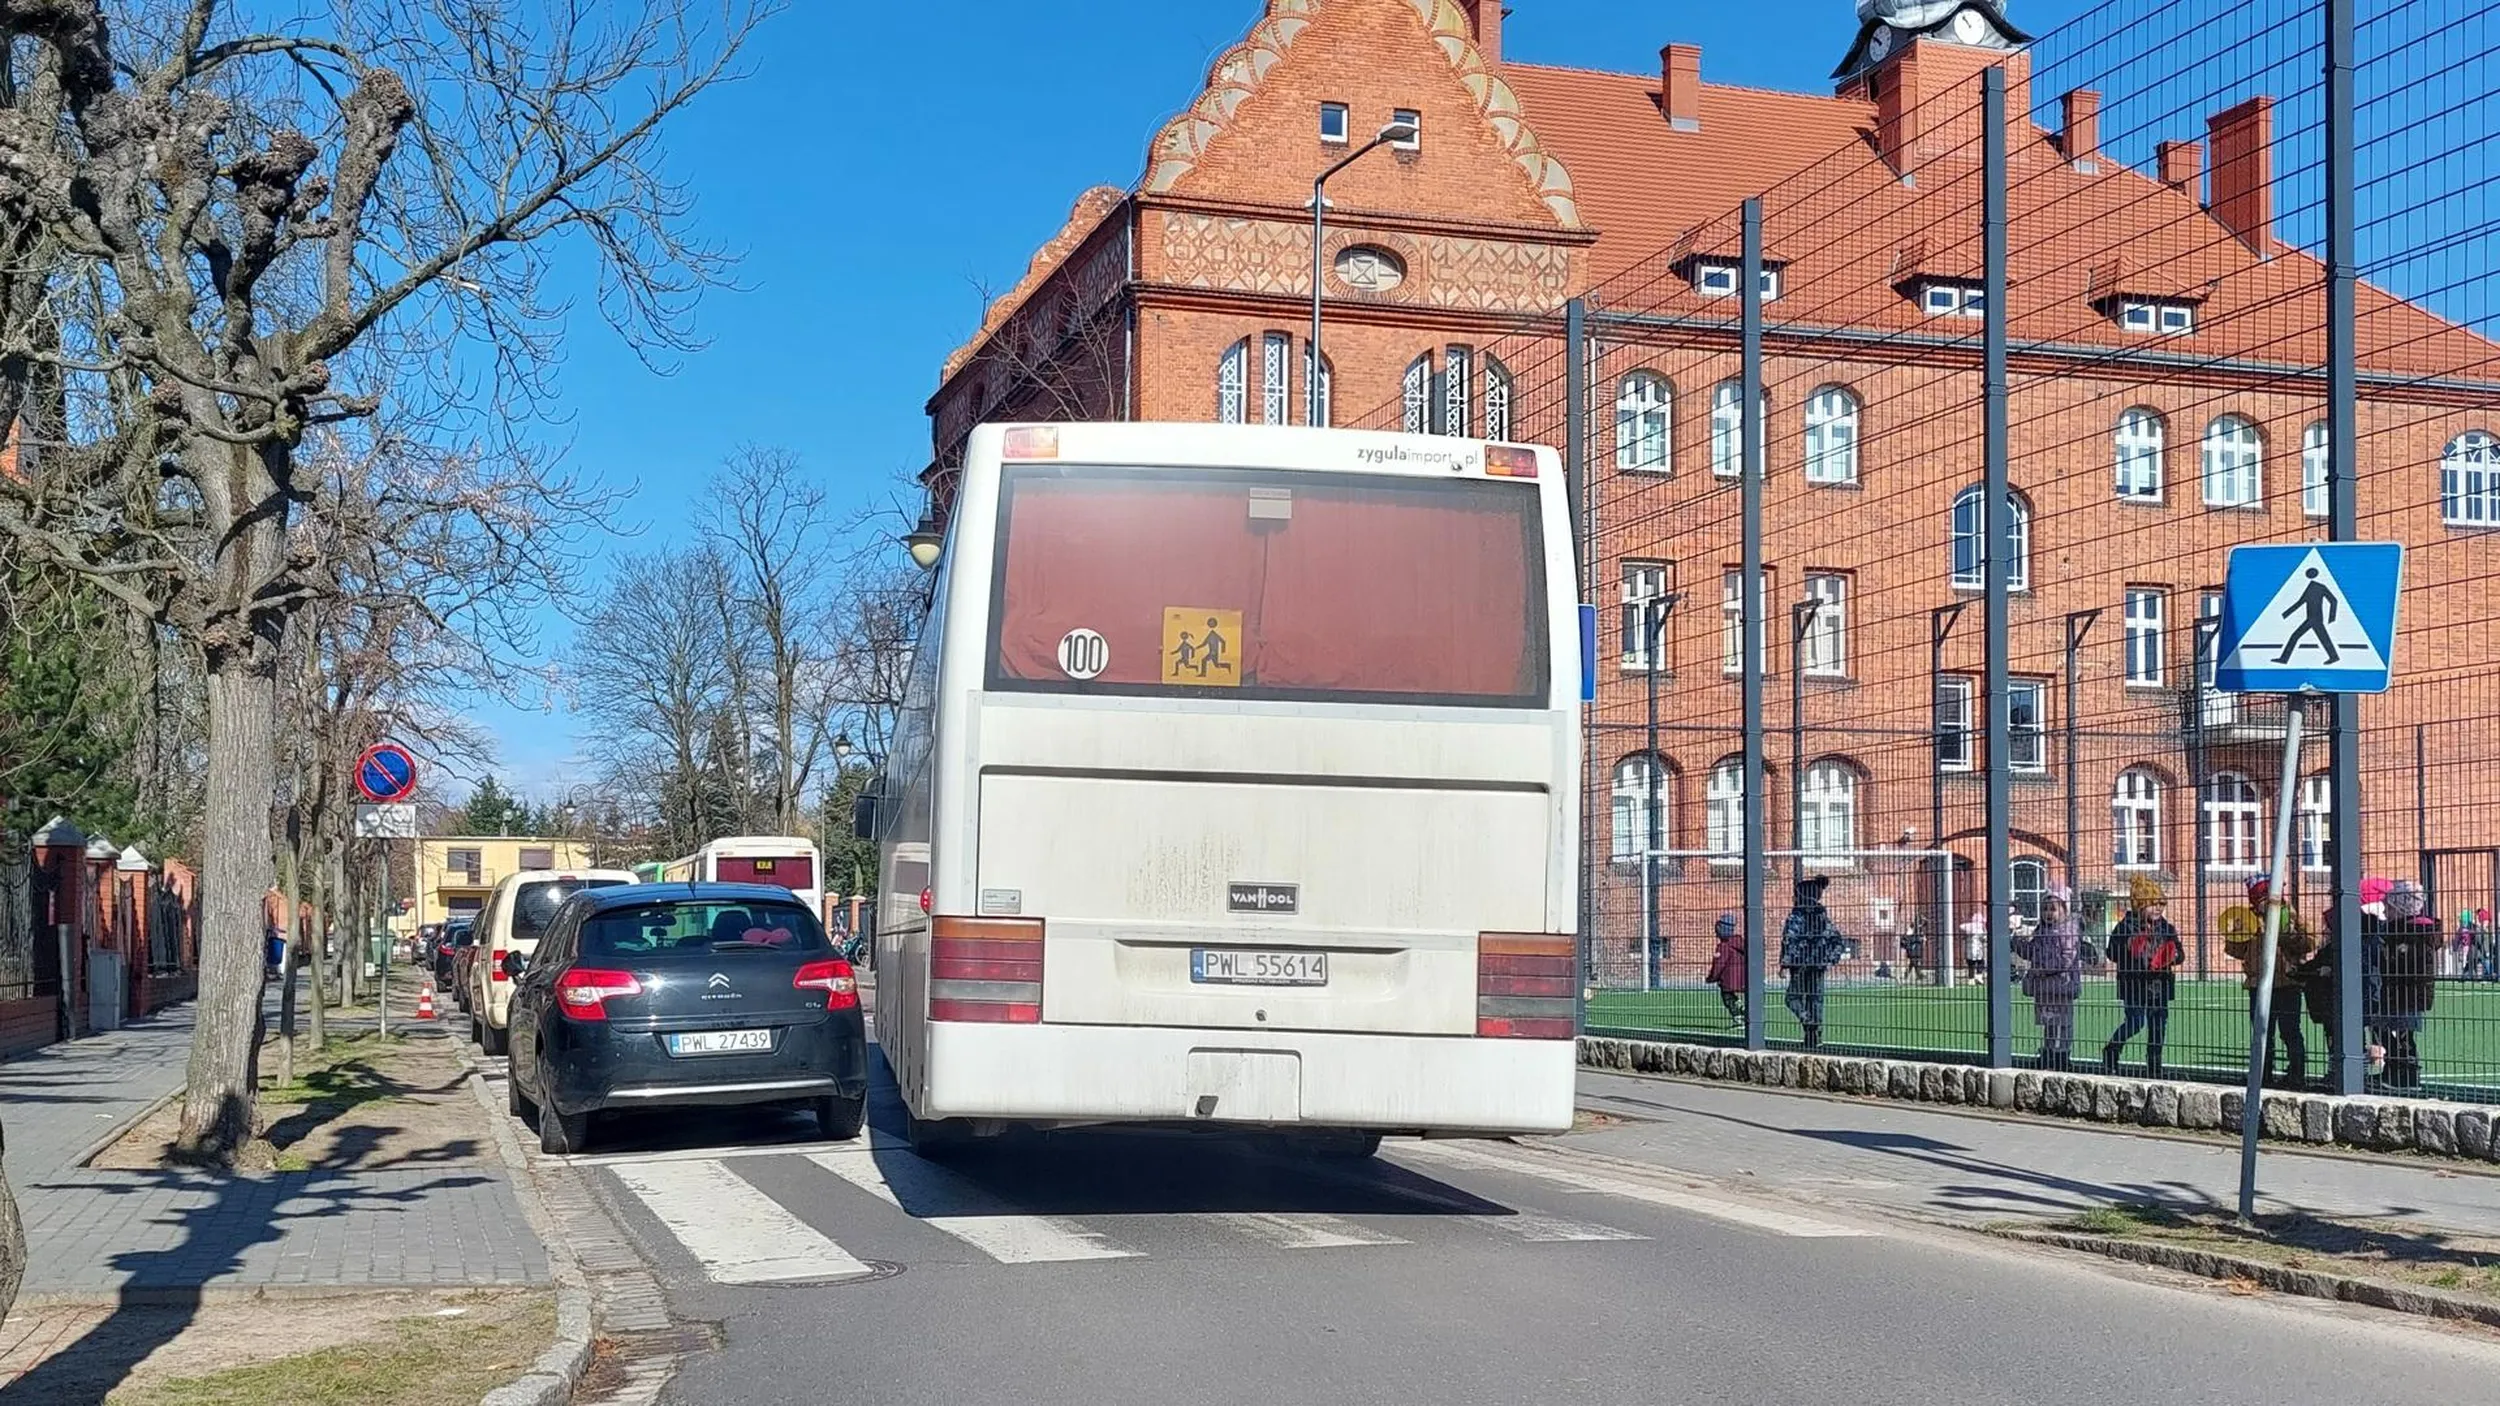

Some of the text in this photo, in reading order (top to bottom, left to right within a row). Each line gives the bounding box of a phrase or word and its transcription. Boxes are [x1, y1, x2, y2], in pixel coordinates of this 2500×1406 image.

[1064, 634, 1103, 673] 100
[1205, 953, 1323, 978] PWL 55614
[681, 1031, 768, 1051] PWL 27439
